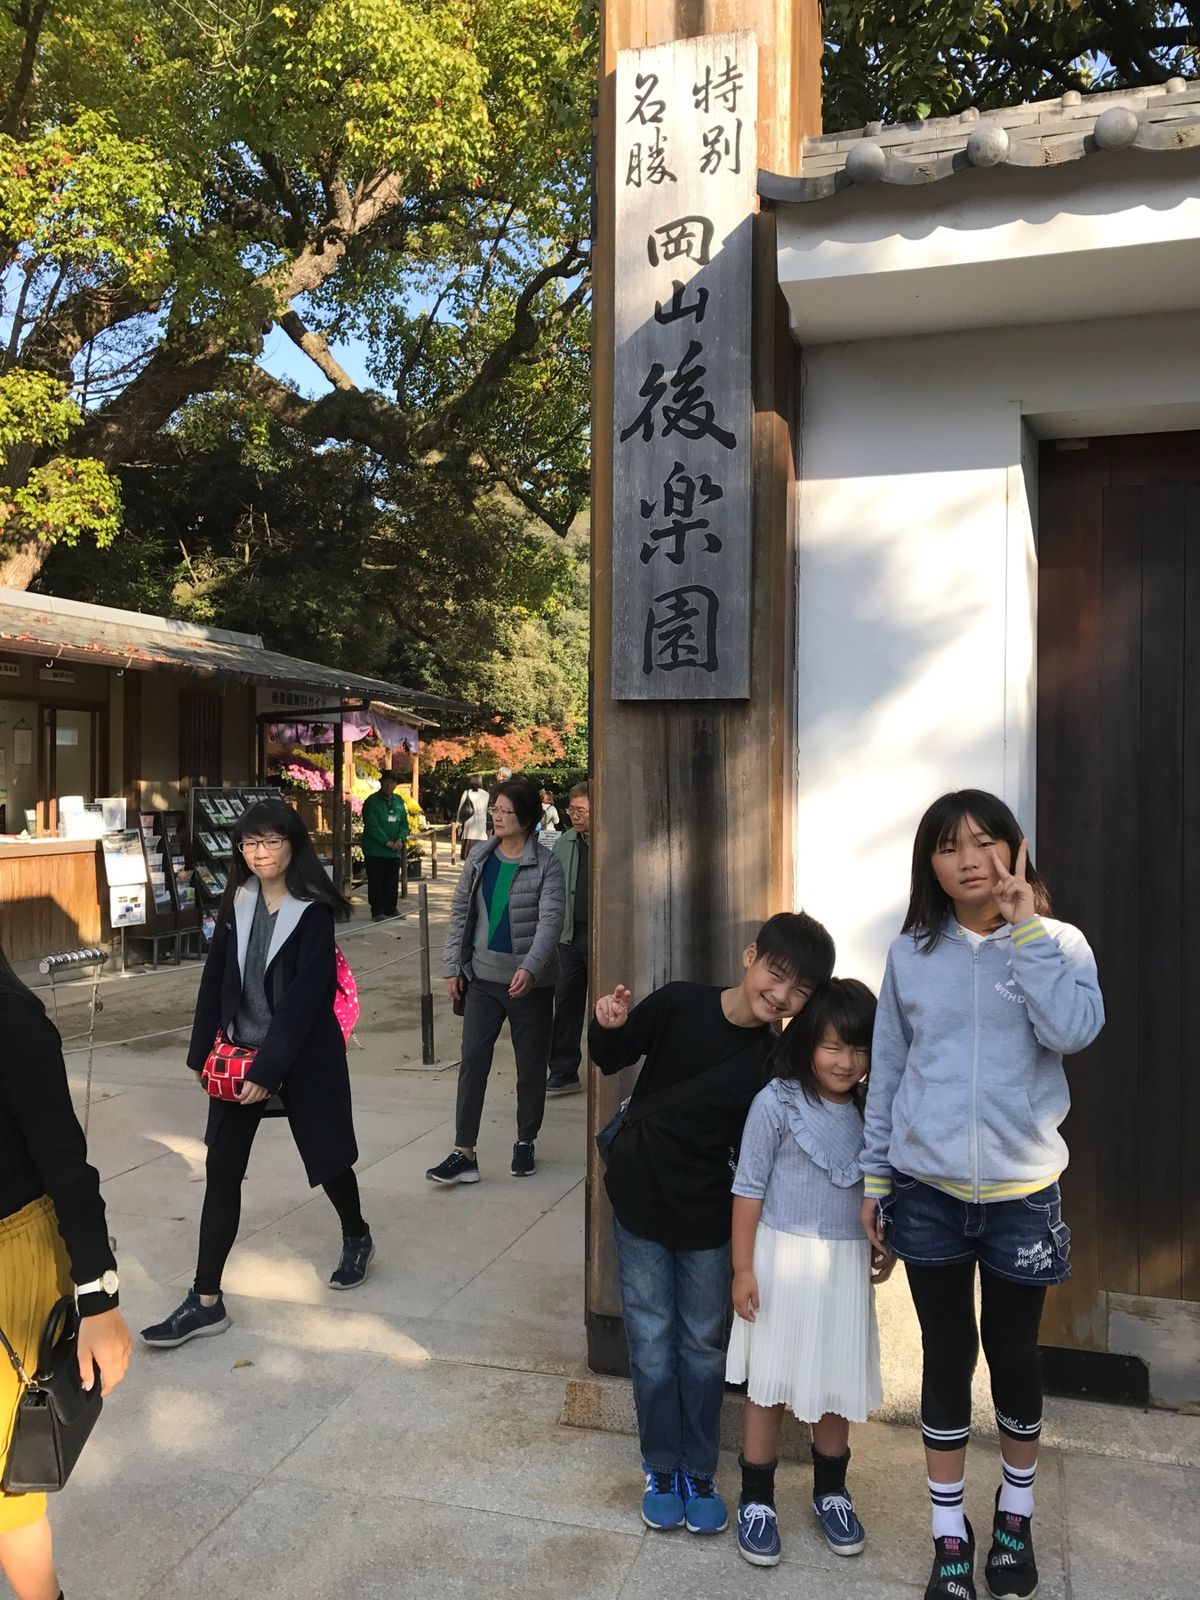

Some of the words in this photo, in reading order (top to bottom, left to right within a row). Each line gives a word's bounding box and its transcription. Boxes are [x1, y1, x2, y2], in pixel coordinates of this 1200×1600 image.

[625, 73, 678, 188] 名勝
[693, 56, 744, 175] 特別
[620, 215, 737, 675] 岡山後楽園
[940, 1562, 970, 1578] ANAP
[994, 1528, 1025, 1552] ANAP
